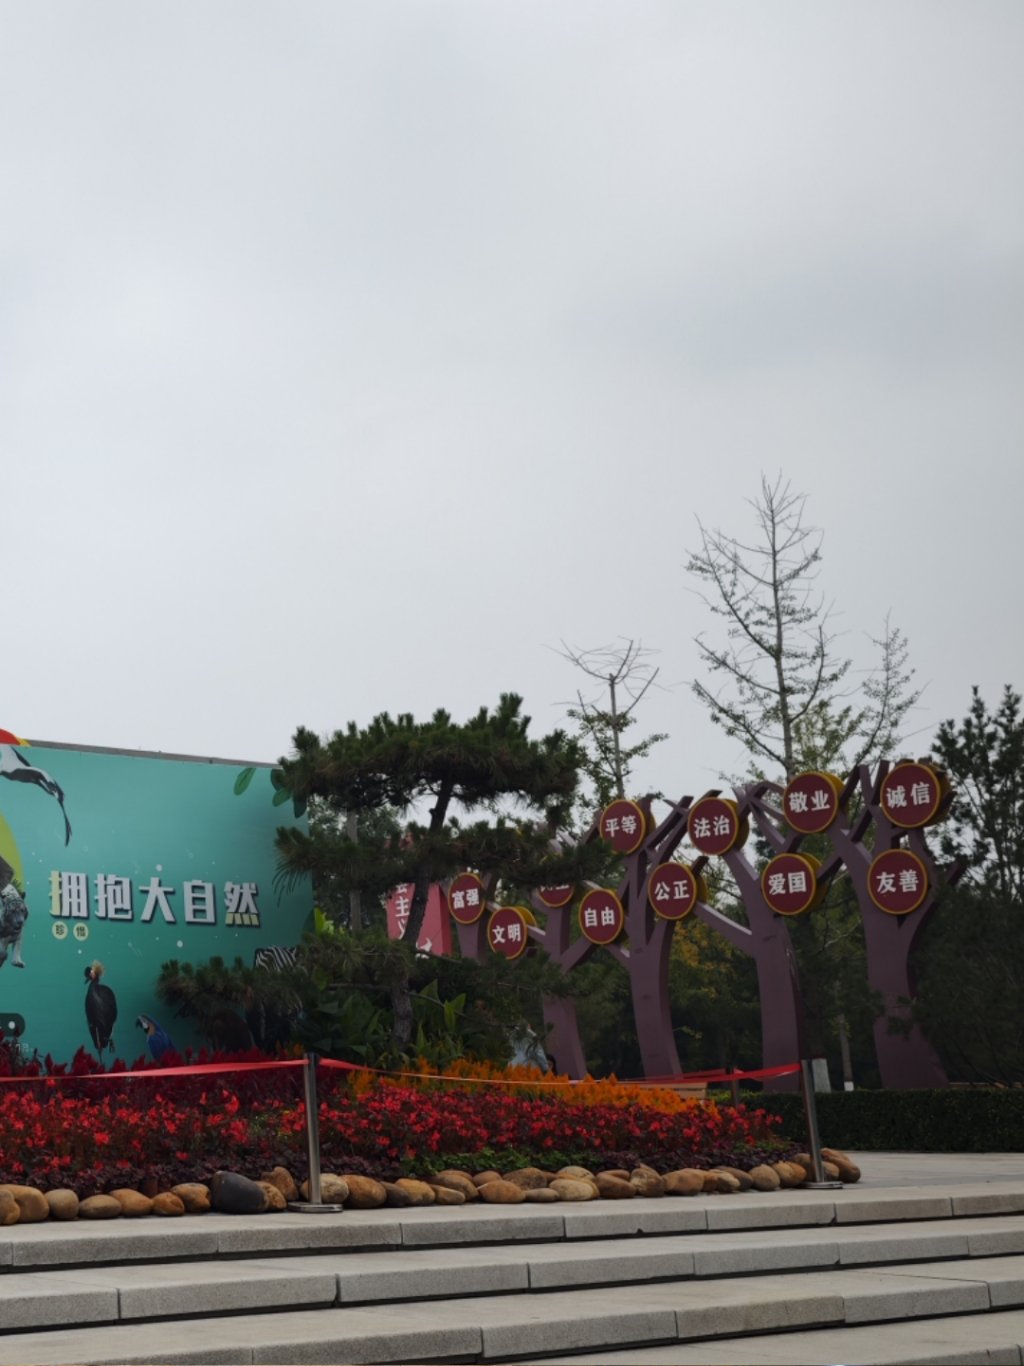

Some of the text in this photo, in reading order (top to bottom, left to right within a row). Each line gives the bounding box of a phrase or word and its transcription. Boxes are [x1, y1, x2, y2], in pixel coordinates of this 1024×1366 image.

[788, 790, 830, 813] 敬业
[886, 782, 930, 808] 诚信
[605, 814, 637, 837] 平等
[693, 815, 730, 839] 法治
[654, 879, 690, 901] 公正
[768, 871, 807, 896] 爱国
[876, 870, 919, 894] 友善
[49, 870, 260, 926] 拥抱大自然
[451, 888, 479, 909] 富强
[584, 906, 616, 928] 自由
[492, 923, 522, 944] 文明
